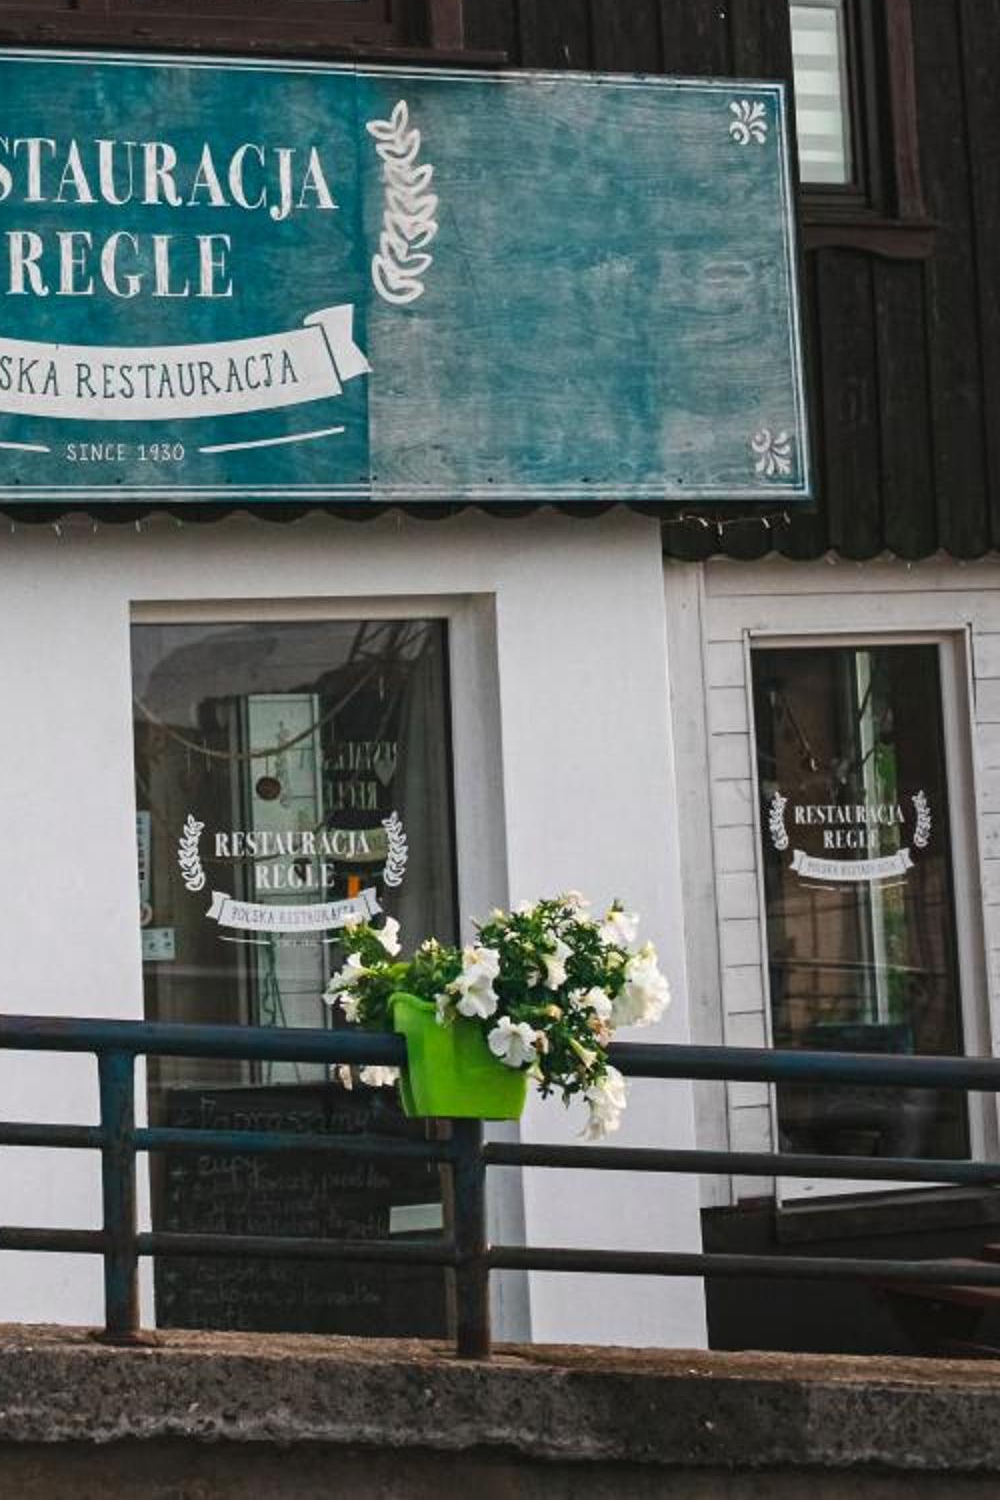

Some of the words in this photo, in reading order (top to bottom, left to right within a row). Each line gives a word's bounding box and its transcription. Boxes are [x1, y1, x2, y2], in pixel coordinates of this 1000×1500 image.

[4, 231, 234, 299] REGLE
[75, 349, 298, 398] RESTAURACJA
[65, 443, 127, 462] SINCE
[137, 442, 186, 462] 1930
[795, 804, 905, 826] RESTAURACJA
[214, 831, 370, 859] RESTAURACJA
[255, 863, 336, 890] REGLE
